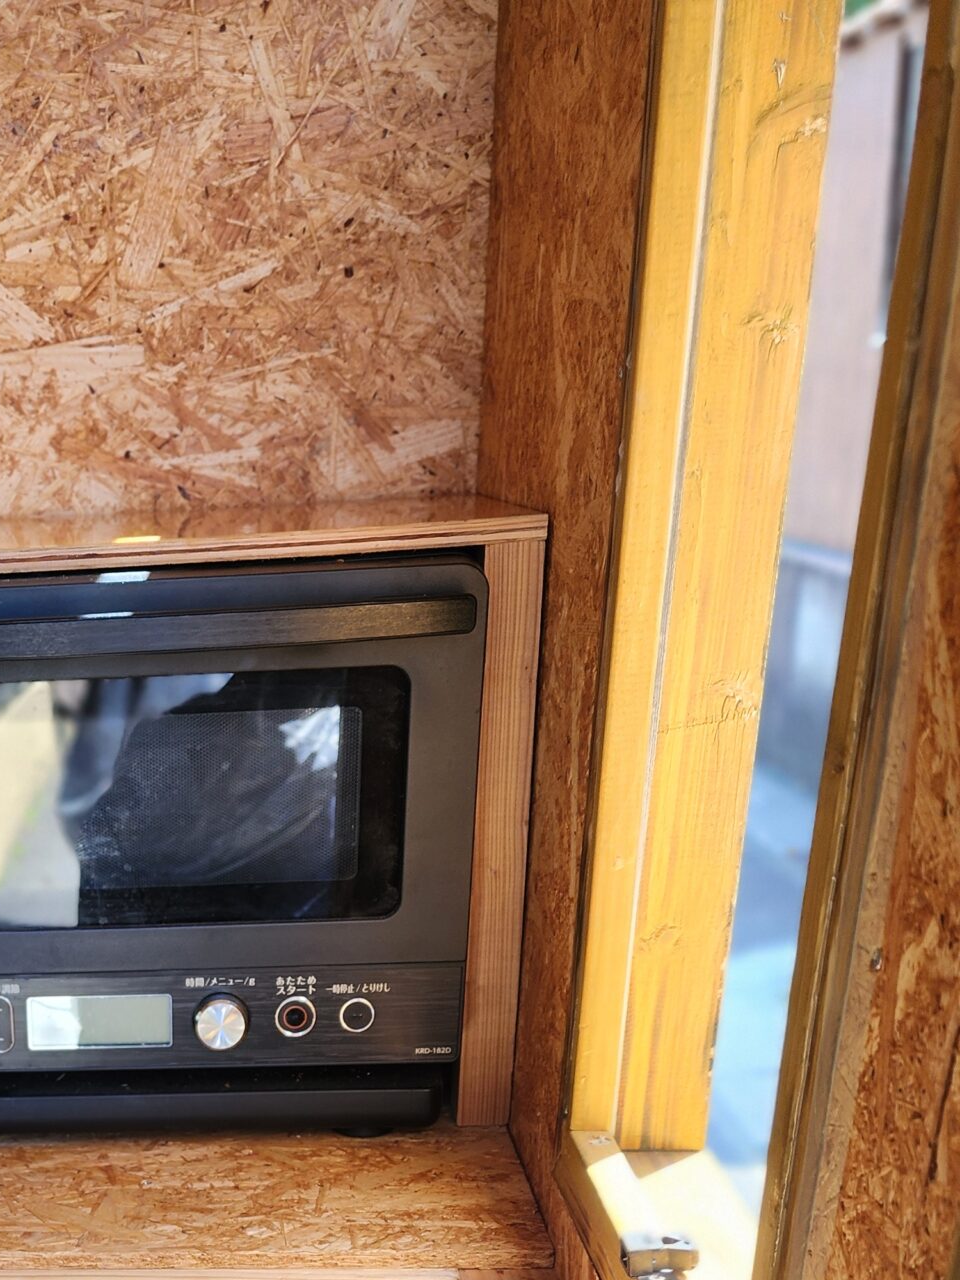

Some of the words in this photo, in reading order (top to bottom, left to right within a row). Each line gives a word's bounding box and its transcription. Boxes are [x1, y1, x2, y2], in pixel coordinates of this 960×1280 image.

[276, 976, 317, 985] あたため
[276, 985, 317, 995] スタート
